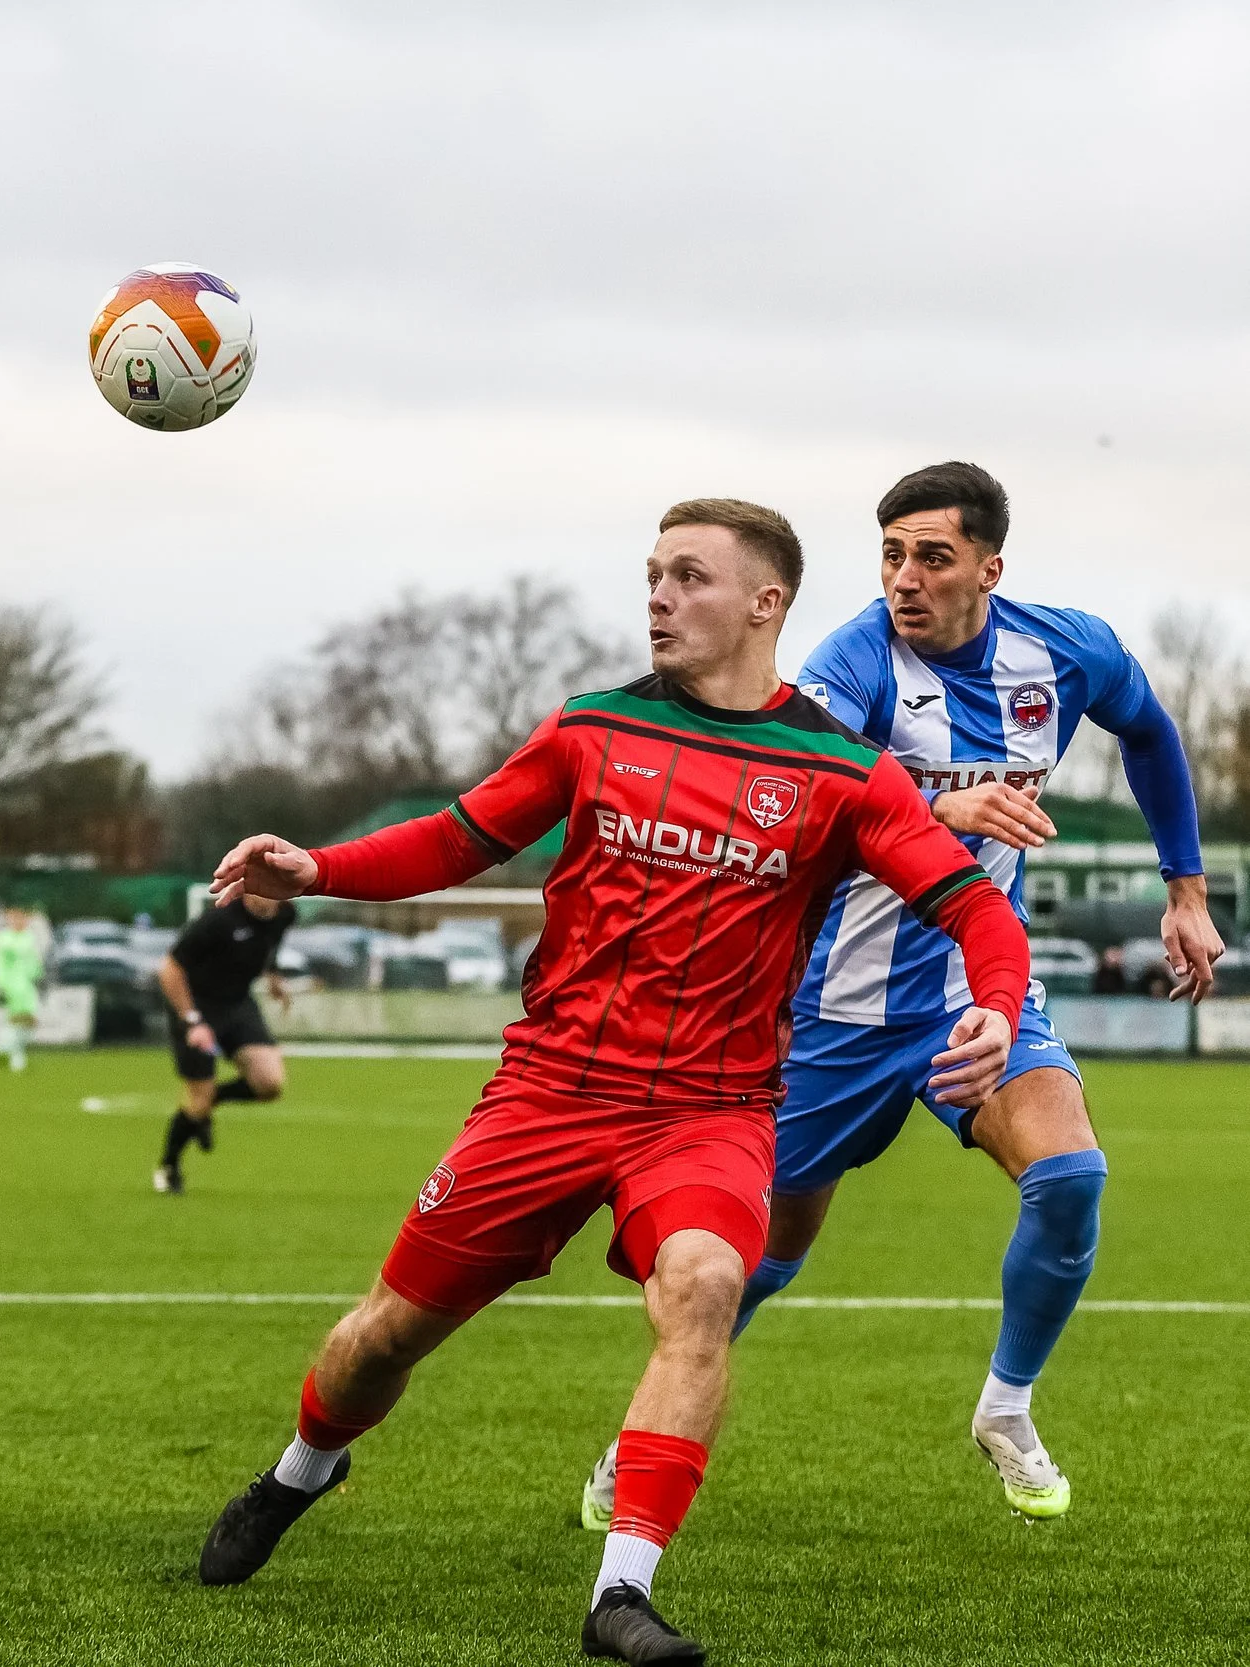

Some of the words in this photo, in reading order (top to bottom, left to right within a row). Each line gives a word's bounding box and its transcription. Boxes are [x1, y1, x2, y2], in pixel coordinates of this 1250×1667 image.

[595, 808, 788, 879] ENDURA
[604, 845, 622, 858] GYM
[626, 851, 709, 875] MANAGEMENT
